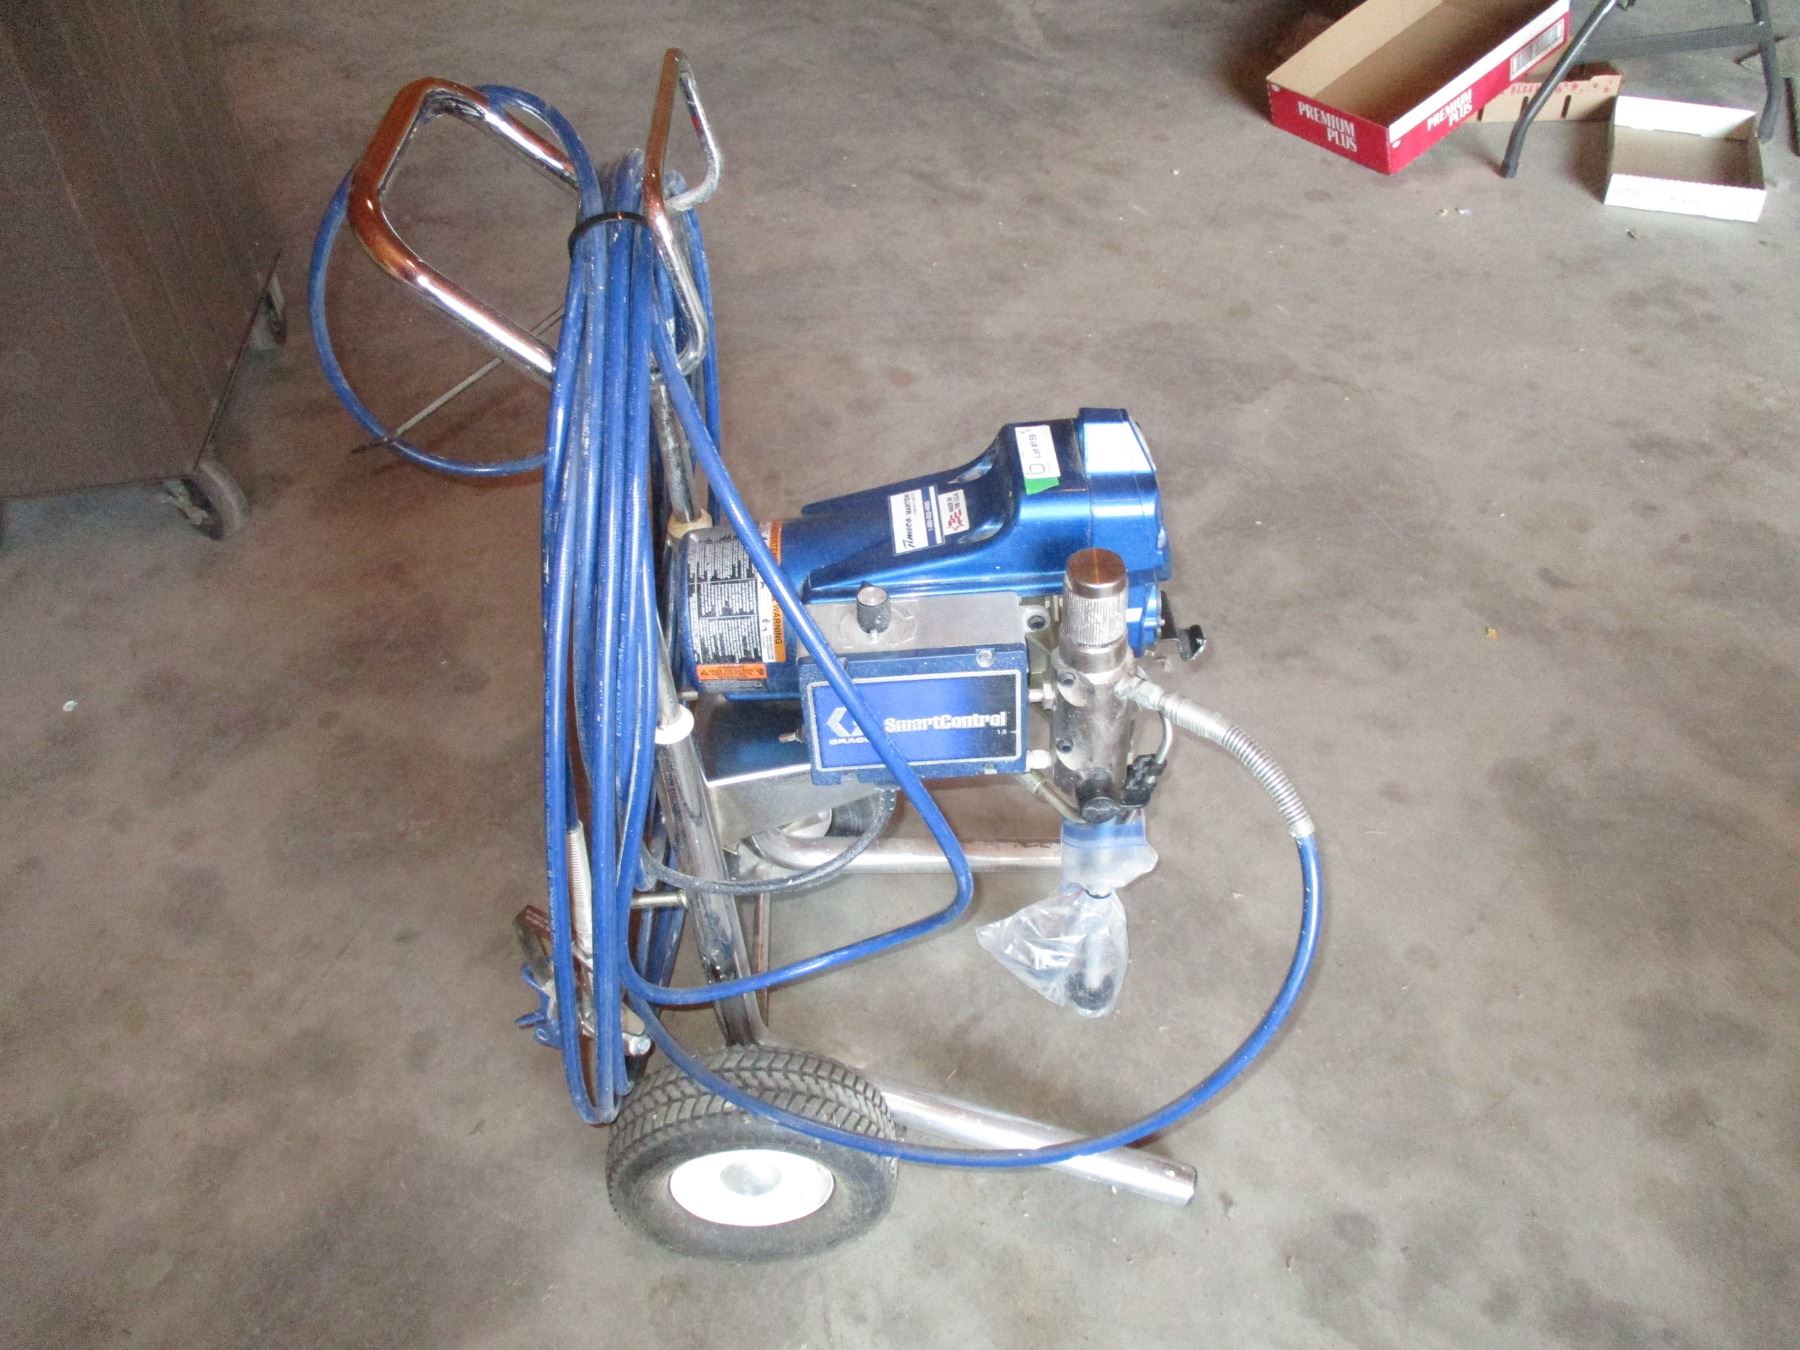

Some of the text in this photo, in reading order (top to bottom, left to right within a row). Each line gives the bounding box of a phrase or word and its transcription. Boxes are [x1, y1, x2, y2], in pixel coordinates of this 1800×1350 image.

[1298, 101, 1355, 137] PREMIUM
[1327, 127, 1357, 152] PLUS
[884, 711, 1007, 733] SmartControl
